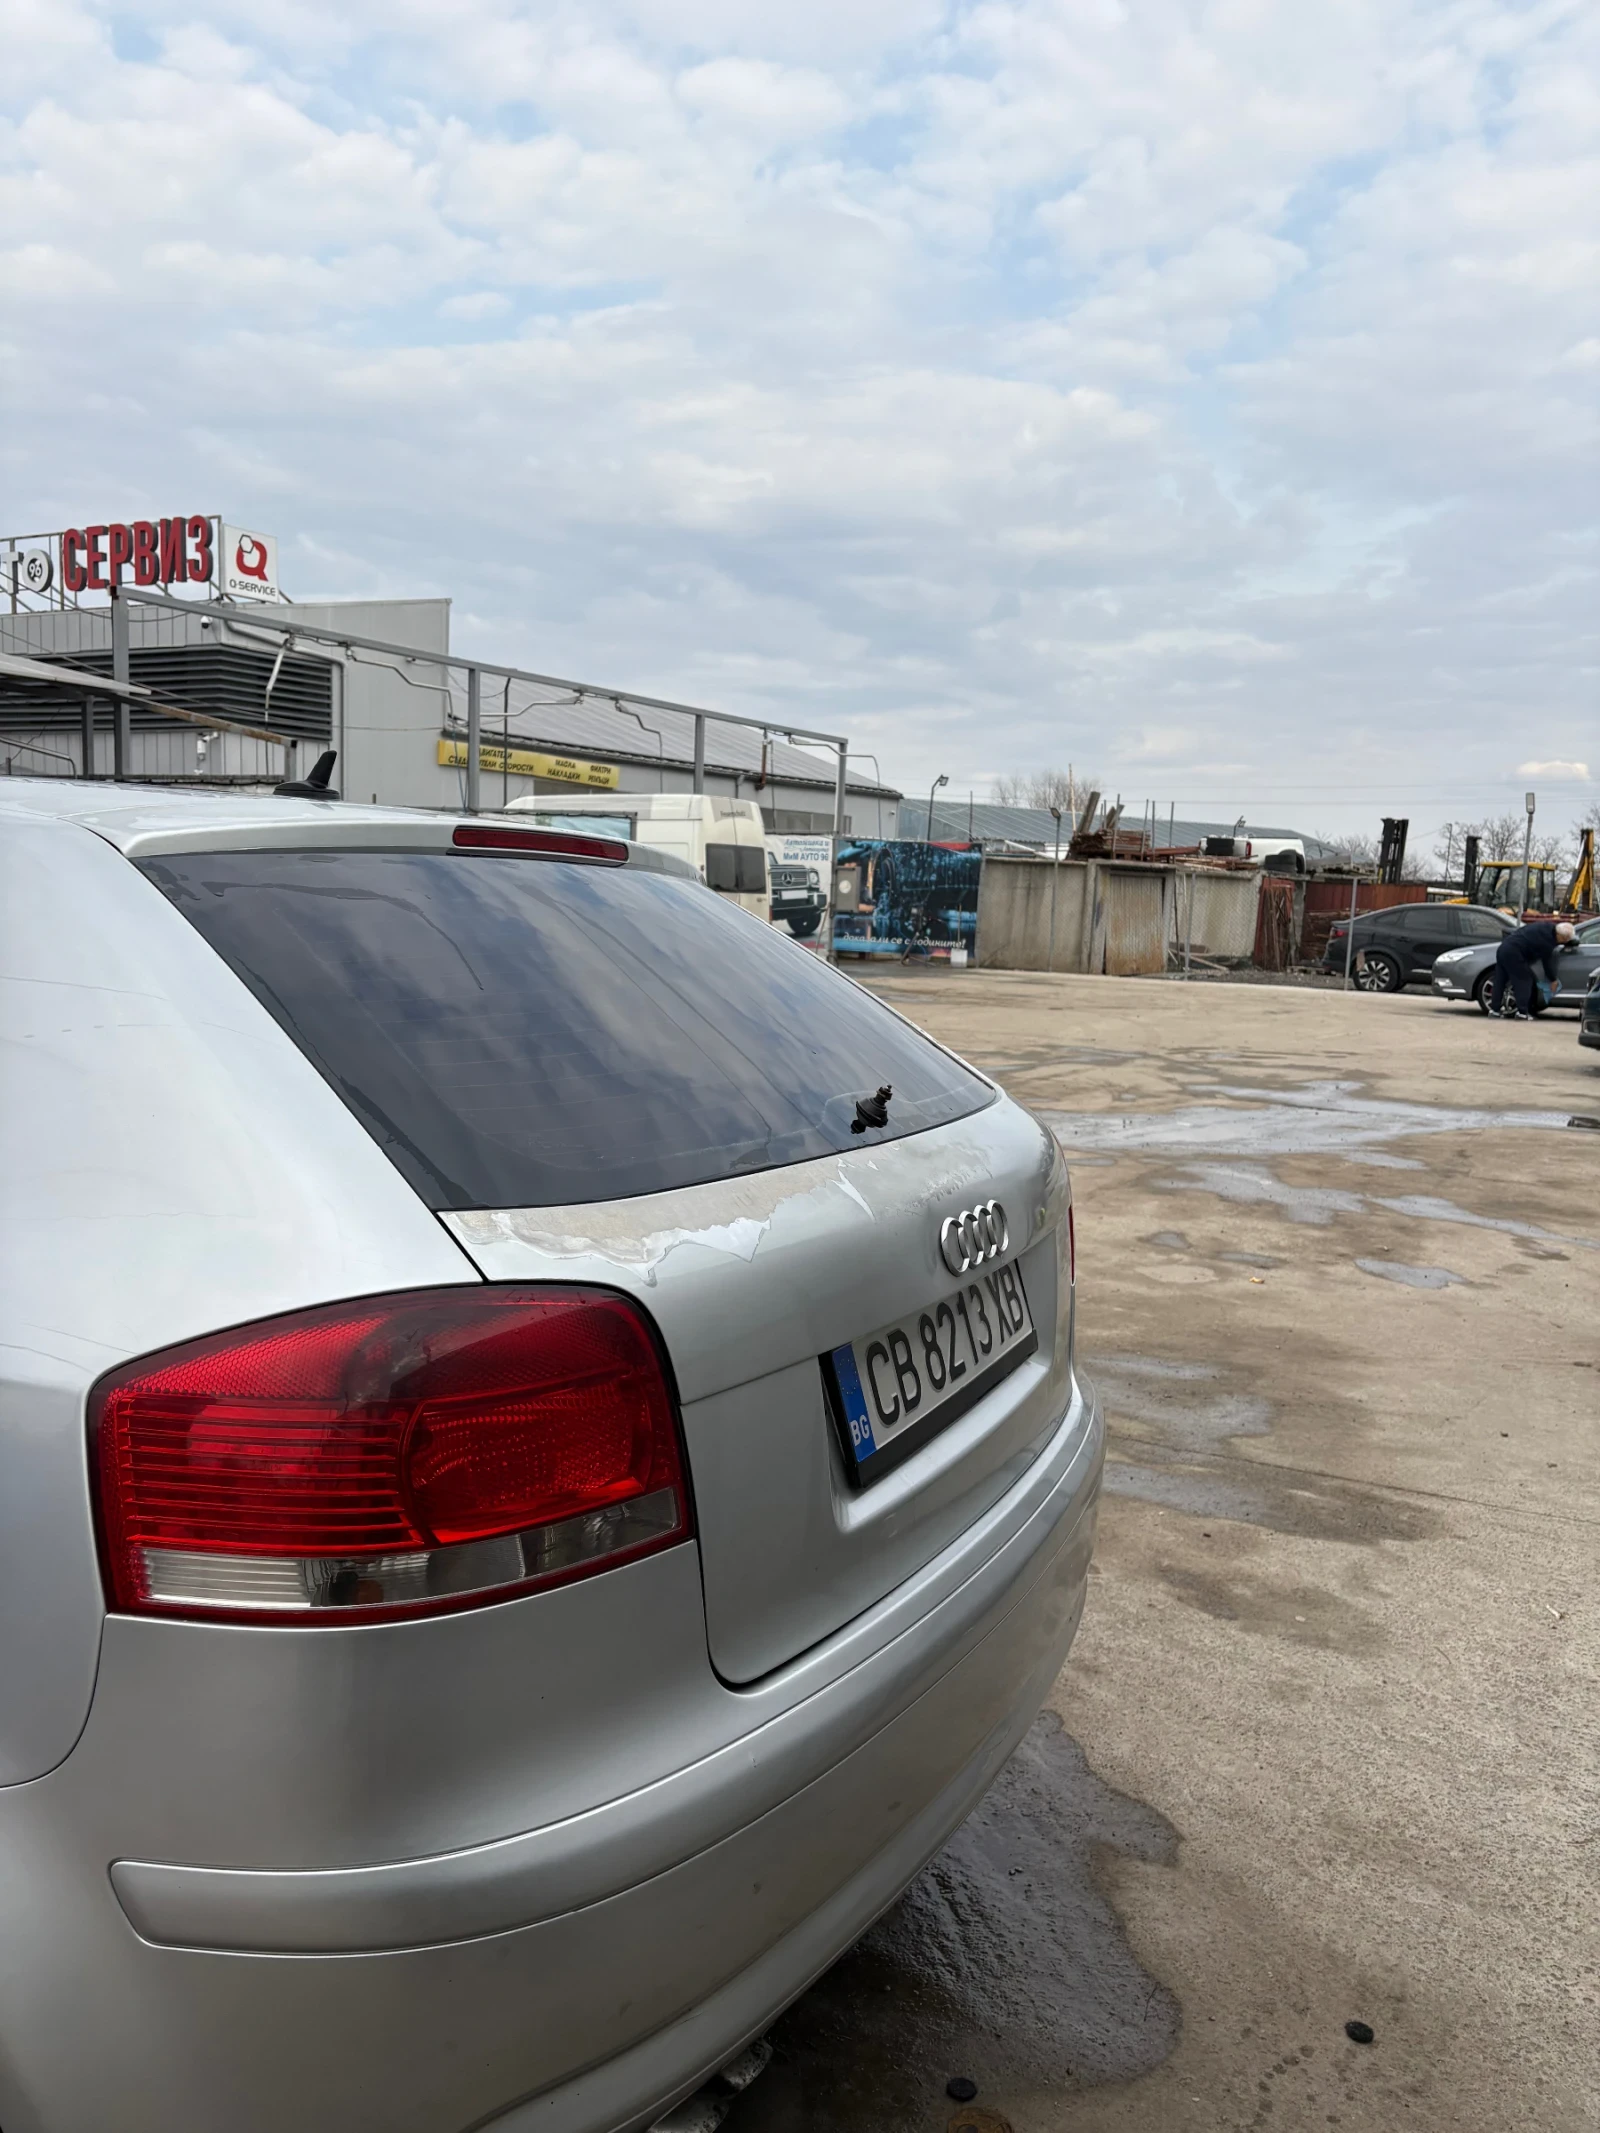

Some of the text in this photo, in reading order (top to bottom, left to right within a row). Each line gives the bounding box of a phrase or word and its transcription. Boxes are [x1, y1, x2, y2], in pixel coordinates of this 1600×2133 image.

[63, 515, 212, 592] СЕРВИЗ
[547, 768, 581, 781] НАКЛАДКИ
[800, 852, 820, 861] АУТО
[820, 853, 830, 861] 96
[890, 937, 903, 945] се
[866, 1263, 1024, 1428] CB 8213 XB
[850, 1414, 870, 1447] BG
